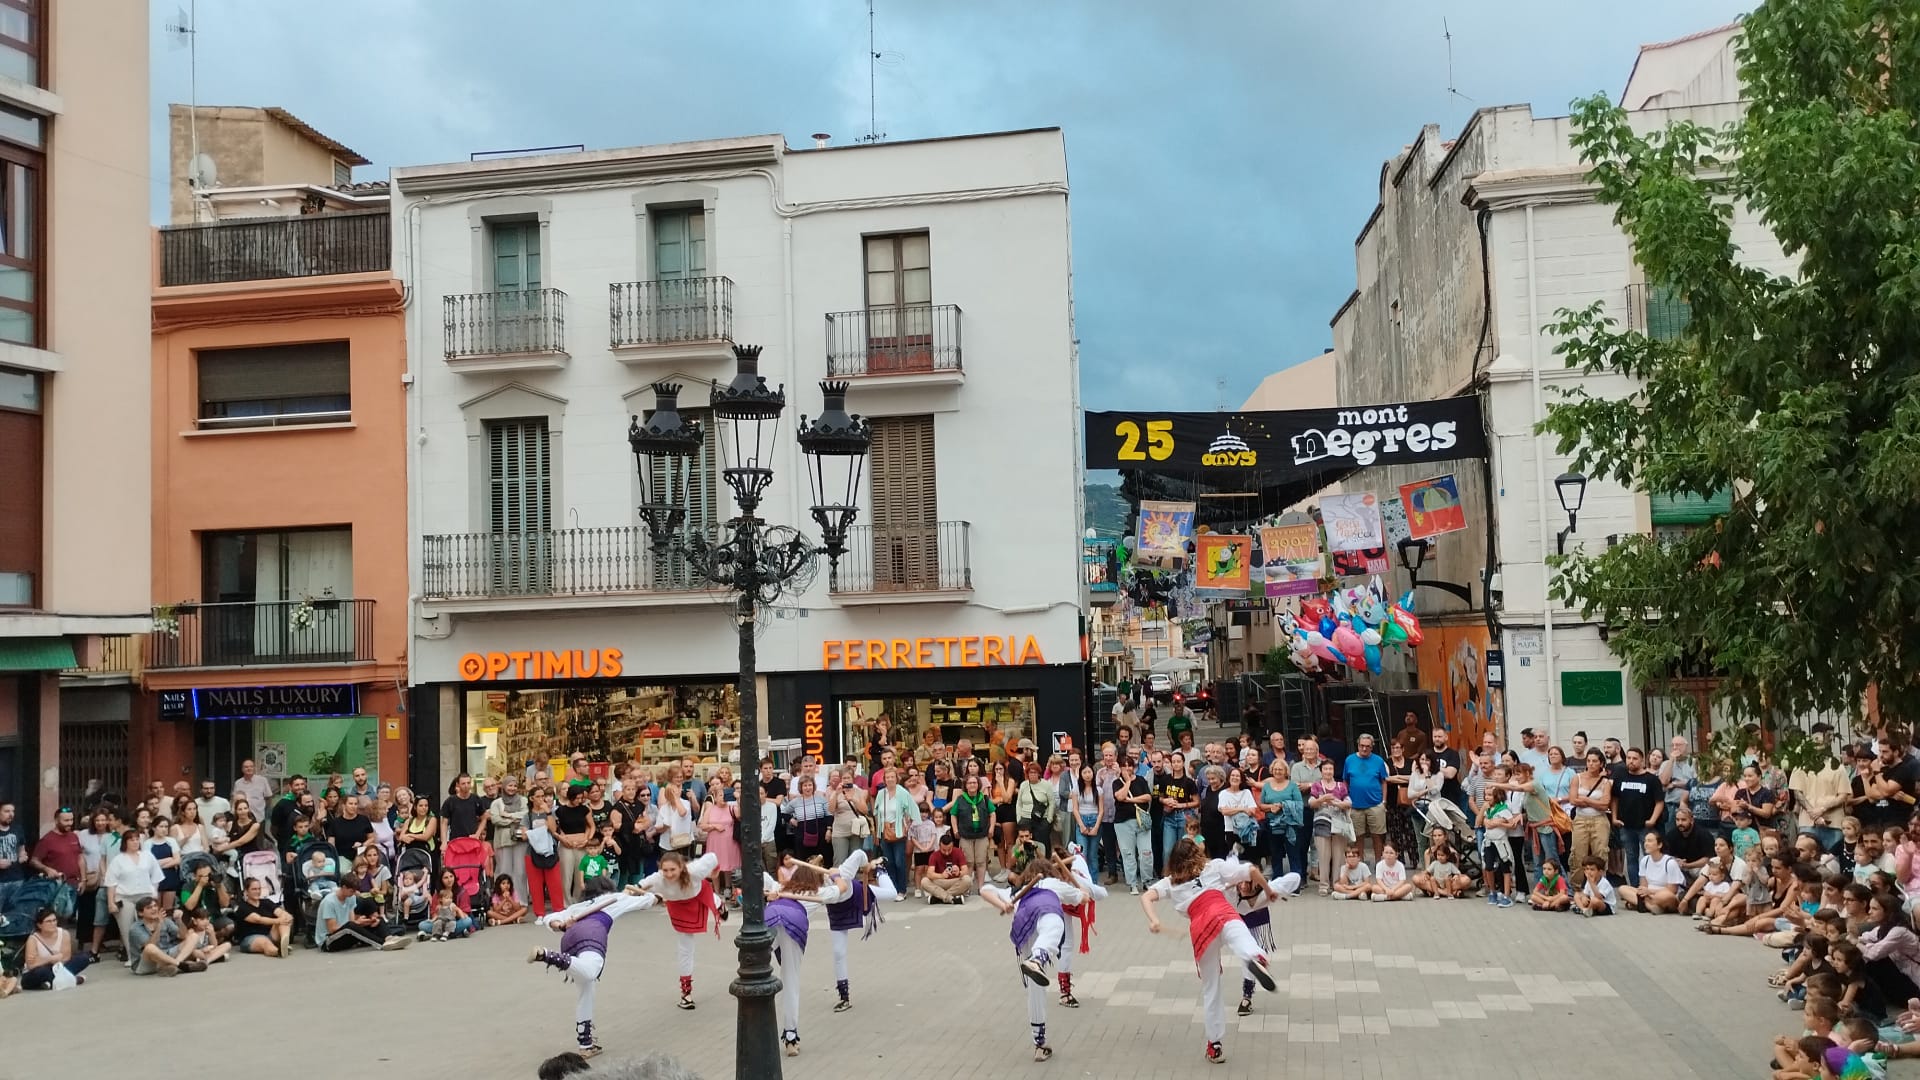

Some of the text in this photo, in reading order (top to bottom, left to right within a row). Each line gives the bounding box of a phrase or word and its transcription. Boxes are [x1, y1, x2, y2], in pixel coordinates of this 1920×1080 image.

[1337, 405, 1408, 425] mont
[1115, 420, 1257, 467] 25 anys
[1290, 421, 1457, 466] negres
[458, 647, 623, 682] OPTIMUS
[823, 634, 1046, 670] FERRETERIA
[164, 693, 185, 702] NAILS
[208, 687, 343, 706] NAILS LUXURY
